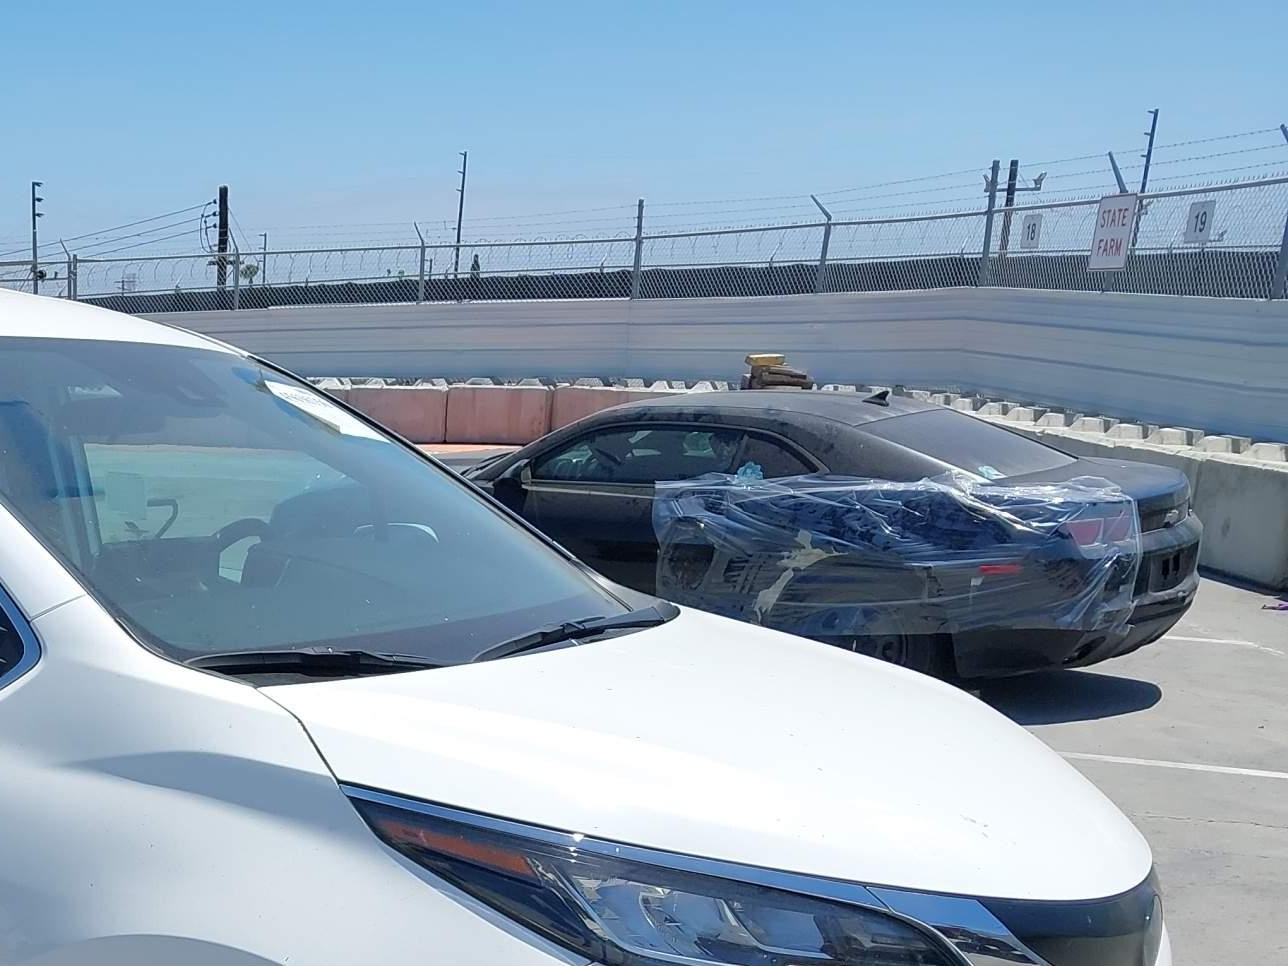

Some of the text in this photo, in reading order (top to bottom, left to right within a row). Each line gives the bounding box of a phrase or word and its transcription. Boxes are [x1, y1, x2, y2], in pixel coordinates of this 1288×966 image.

[1100, 207, 1129, 227] STATE
[1194, 211, 1207, 233] 19
[1026, 223, 1037, 241] 18
[1097, 239, 1122, 257] FARM
